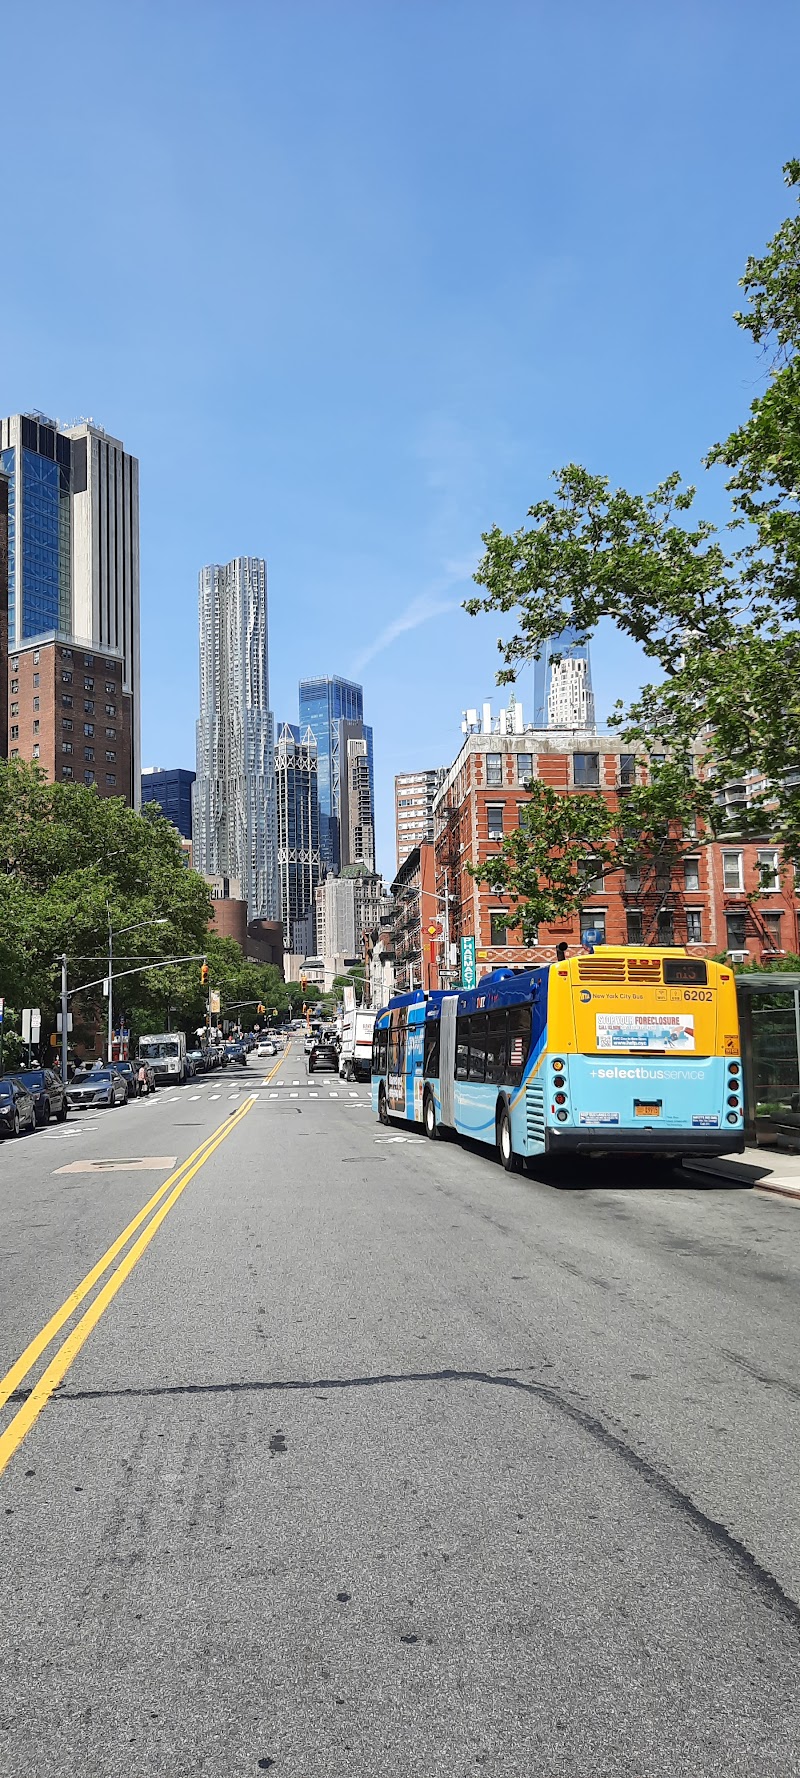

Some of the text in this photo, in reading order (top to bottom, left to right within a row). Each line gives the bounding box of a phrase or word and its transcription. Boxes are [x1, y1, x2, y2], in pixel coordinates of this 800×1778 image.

[463, 937, 474, 983] PHARMACY
[683, 990, 713, 1002] 6202
[635, 1016, 680, 1026] FORECLOSURE
